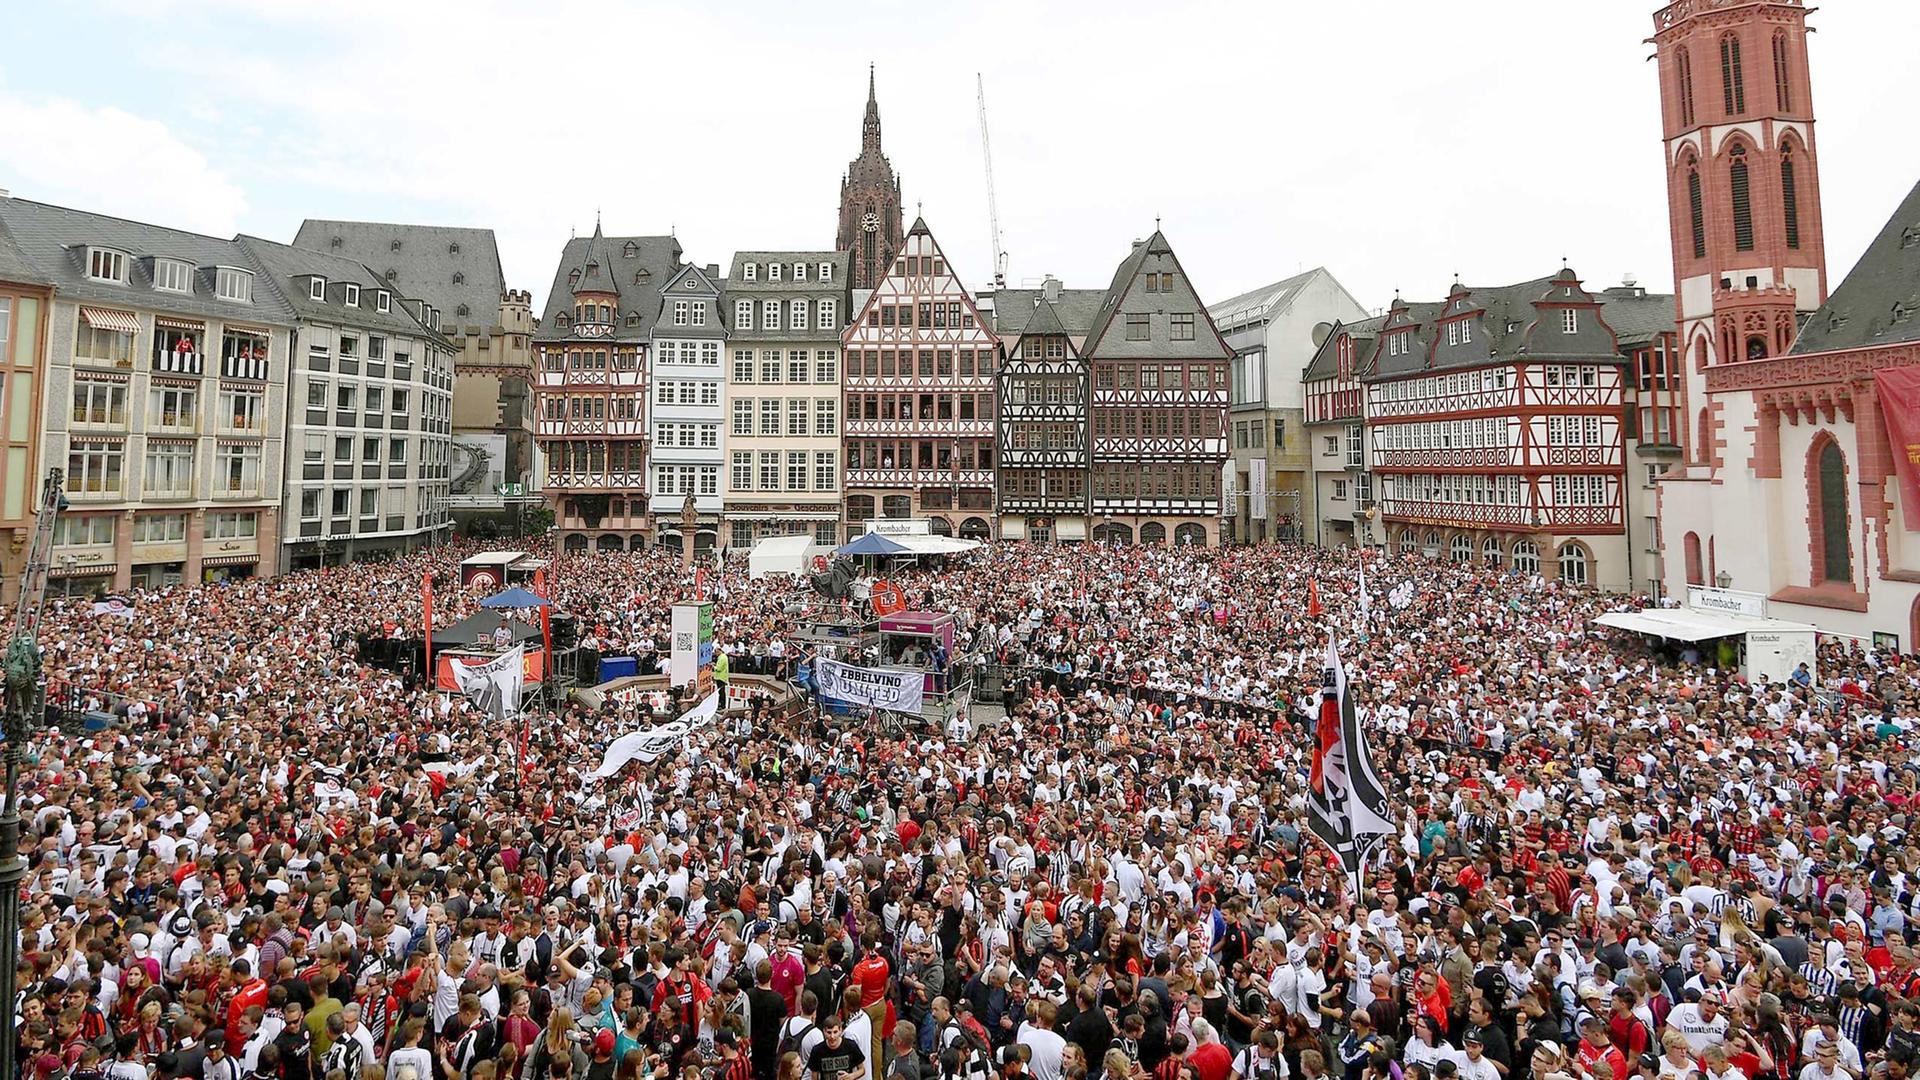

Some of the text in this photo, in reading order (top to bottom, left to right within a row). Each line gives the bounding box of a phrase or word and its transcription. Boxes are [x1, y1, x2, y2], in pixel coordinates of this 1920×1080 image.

[731, 504, 769, 512] Souvenirs
[794, 504, 837, 512] Geschenke
[876, 524, 911, 533] Krombacher
[1701, 594, 1742, 612] Krombacher
[1751, 633, 1780, 642] Krombacher
[840, 668, 901, 688] EBBELVINO
[839, 680, 901, 703] UNITED
